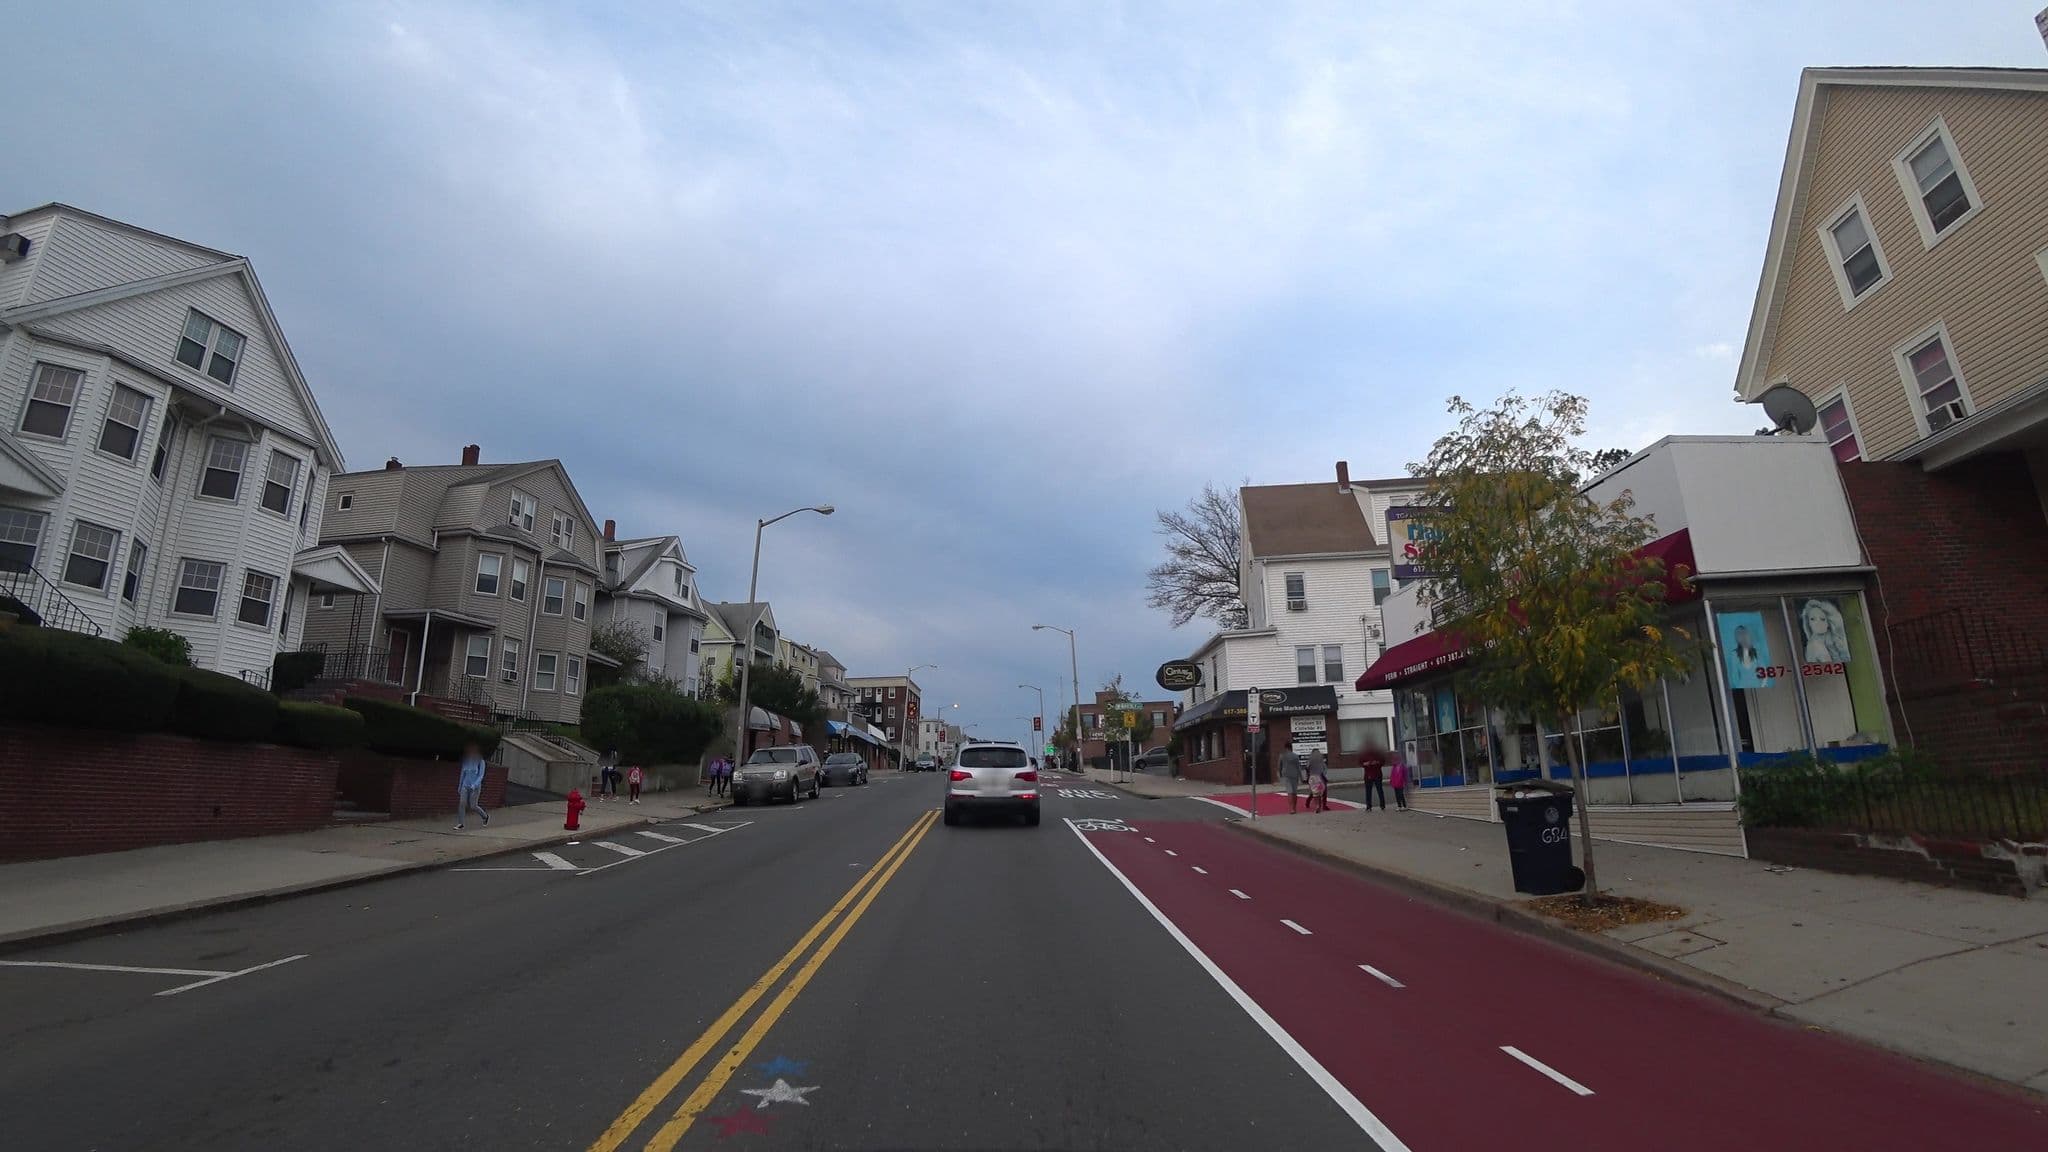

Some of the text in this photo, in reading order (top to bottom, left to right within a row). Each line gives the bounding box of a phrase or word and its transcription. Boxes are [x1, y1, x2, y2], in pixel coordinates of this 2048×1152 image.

[1403, 661, 1429, 676] STRAIGHT
[1436, 655, 1446, 665] 617
[1304, 703, 1331, 712] Analysis
